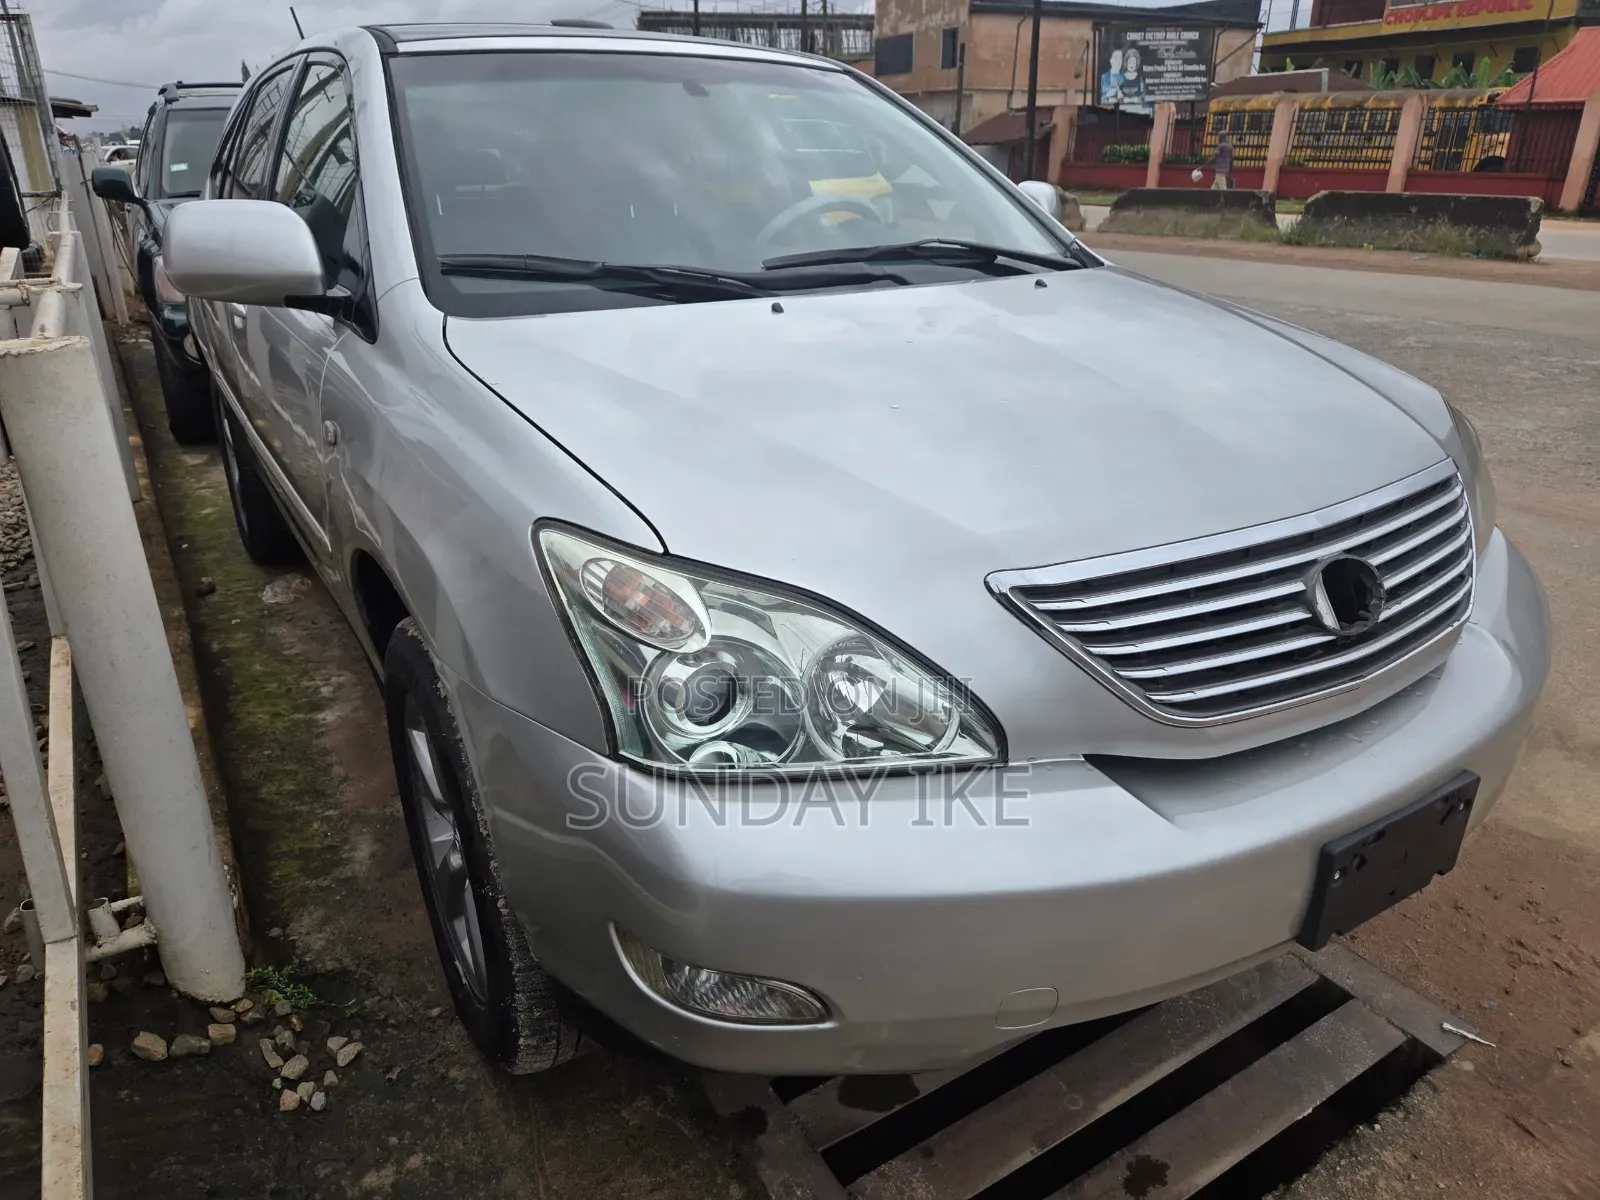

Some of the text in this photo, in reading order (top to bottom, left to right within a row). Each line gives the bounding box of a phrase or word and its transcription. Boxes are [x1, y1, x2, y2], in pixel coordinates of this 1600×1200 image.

[1126, 31, 1145, 40] CHRIST
[1145, 31, 1166, 40] VICTORY
[1180, 31, 1200, 40] CHURCH
